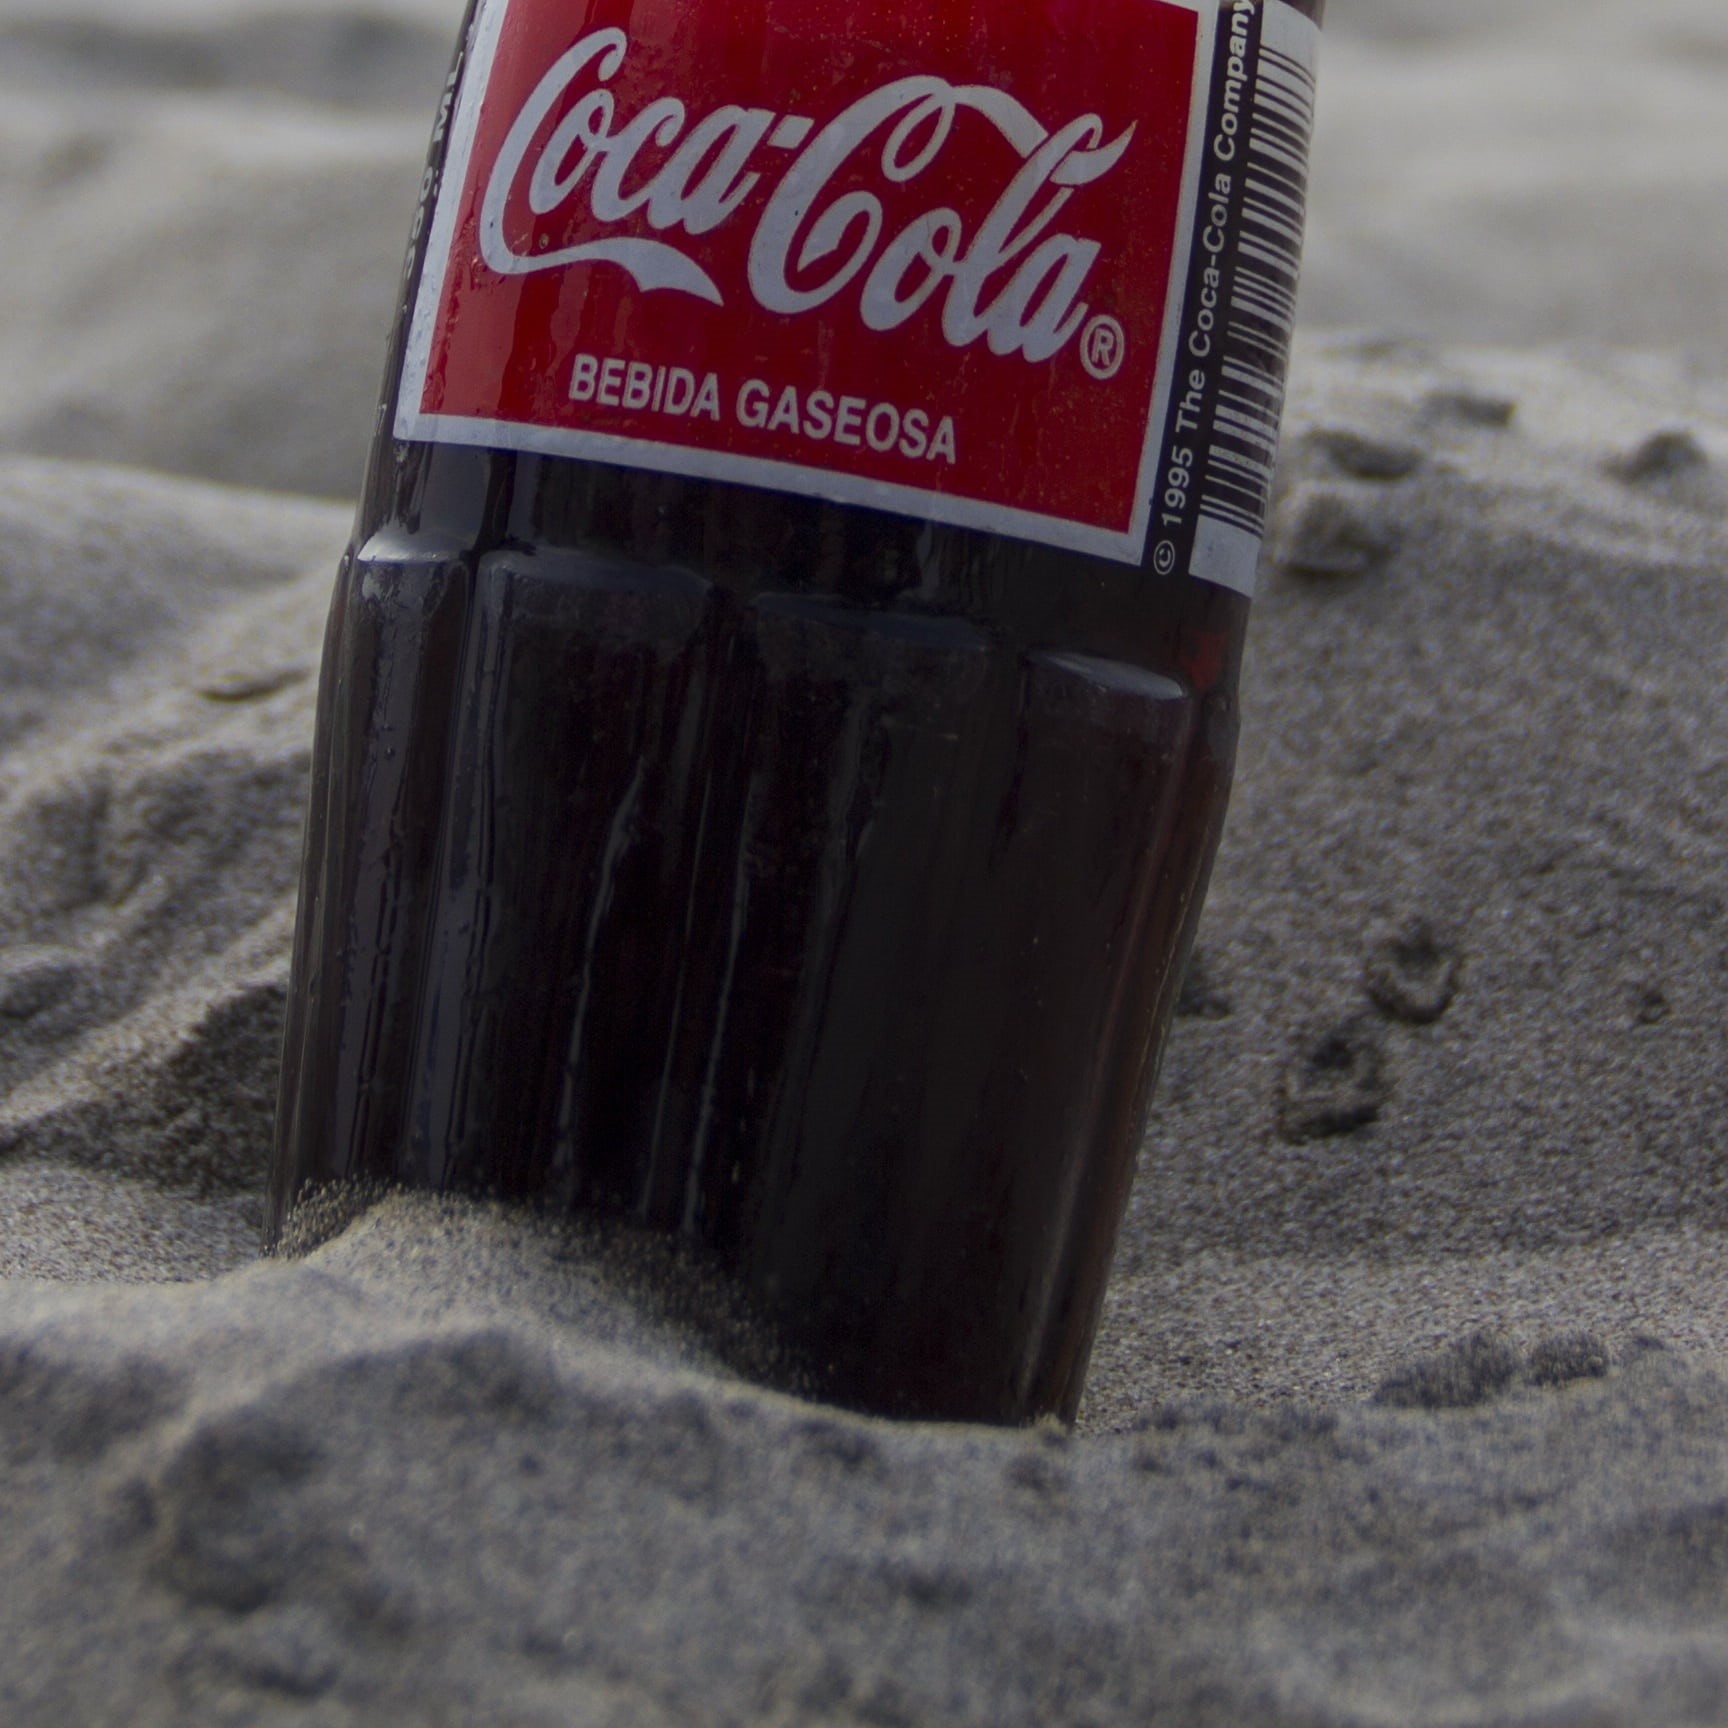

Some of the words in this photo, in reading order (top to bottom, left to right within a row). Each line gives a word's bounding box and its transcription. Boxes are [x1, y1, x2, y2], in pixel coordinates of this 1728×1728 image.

[479, 26, 1138, 363] Coca-Cola
[1188, 174, 1233, 358] Coca-Cola
[568, 353, 721, 421] BEBIDA
[735, 378, 957, 465] GASEOSA
[1175, 368, 1206, 433] The
[1162, 445, 1194, 527] 1995
